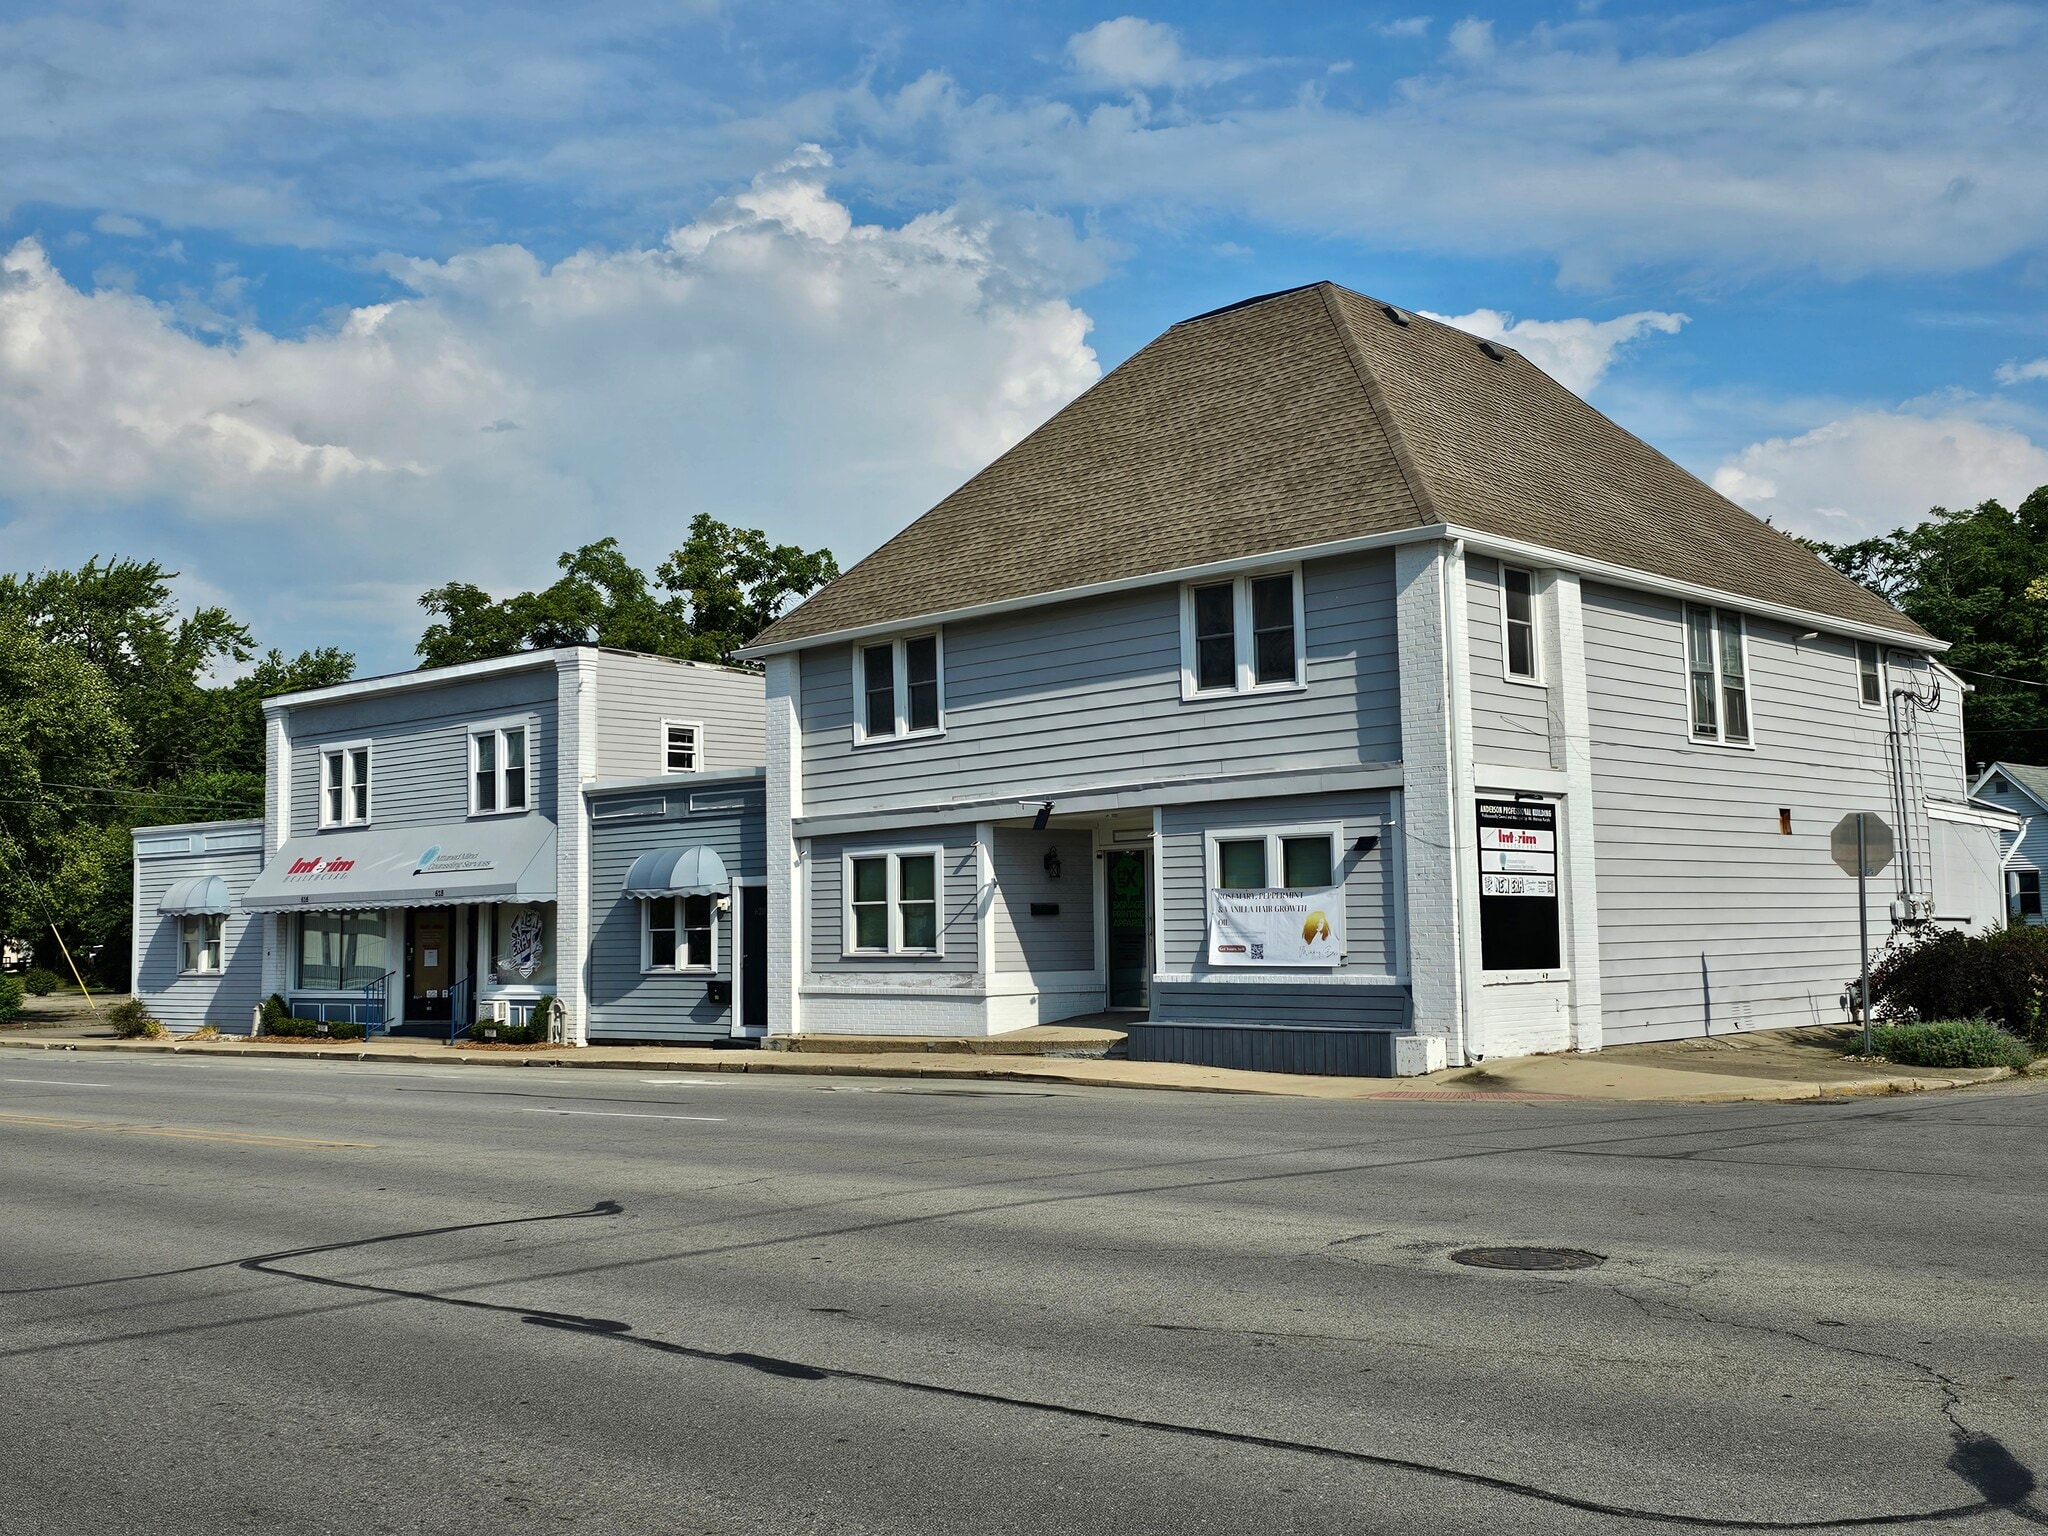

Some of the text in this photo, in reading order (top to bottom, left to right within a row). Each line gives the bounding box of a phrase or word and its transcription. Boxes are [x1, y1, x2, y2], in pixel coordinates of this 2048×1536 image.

[1480, 805, 1552, 817] ANDERSON PROFESSIONAL BUILDING
[1498, 829, 1536, 845] Interim
[287, 856, 354, 875] Interim
[428, 860, 491, 871] Counseling Services
[1511, 877, 1524, 894] ERA
[1217, 891, 1304, 901] ROSEMARY, PEPPERMINT
[1112, 901, 1144, 910] SIGNAGE
[1255, 905, 1273, 913] HAIR
[1274, 904, 1307, 913] GROWTH
[521, 909, 540, 929] NEW
[1112, 910, 1144, 918] PRINTING
[1112, 919, 1144, 928] APPAREL
[1218, 918, 1229, 926] OIL
[511, 934, 529, 957] ERA
